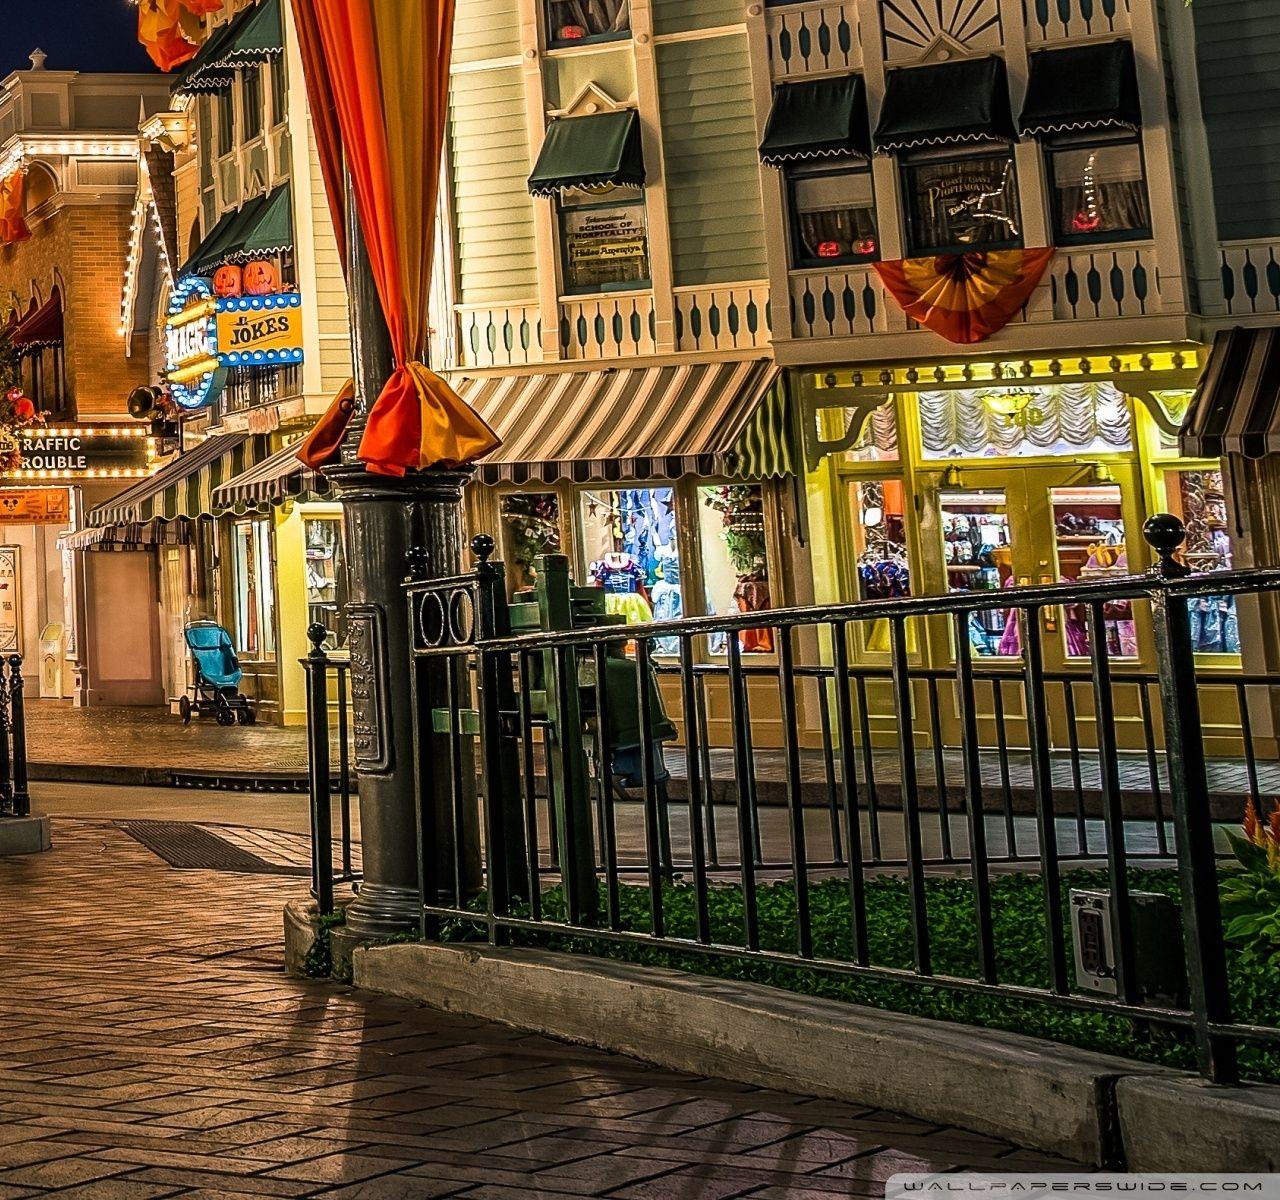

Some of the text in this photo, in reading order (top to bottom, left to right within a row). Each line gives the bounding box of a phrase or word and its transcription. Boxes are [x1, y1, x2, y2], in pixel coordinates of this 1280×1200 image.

[574, 228, 639, 240] HOSPITALITY
[579, 223, 618, 232] SCHOOL
[230, 316, 290, 345] JOKES
[22, 437, 81, 451] RAFFIC
[21, 455, 87, 469] ROUBLE
